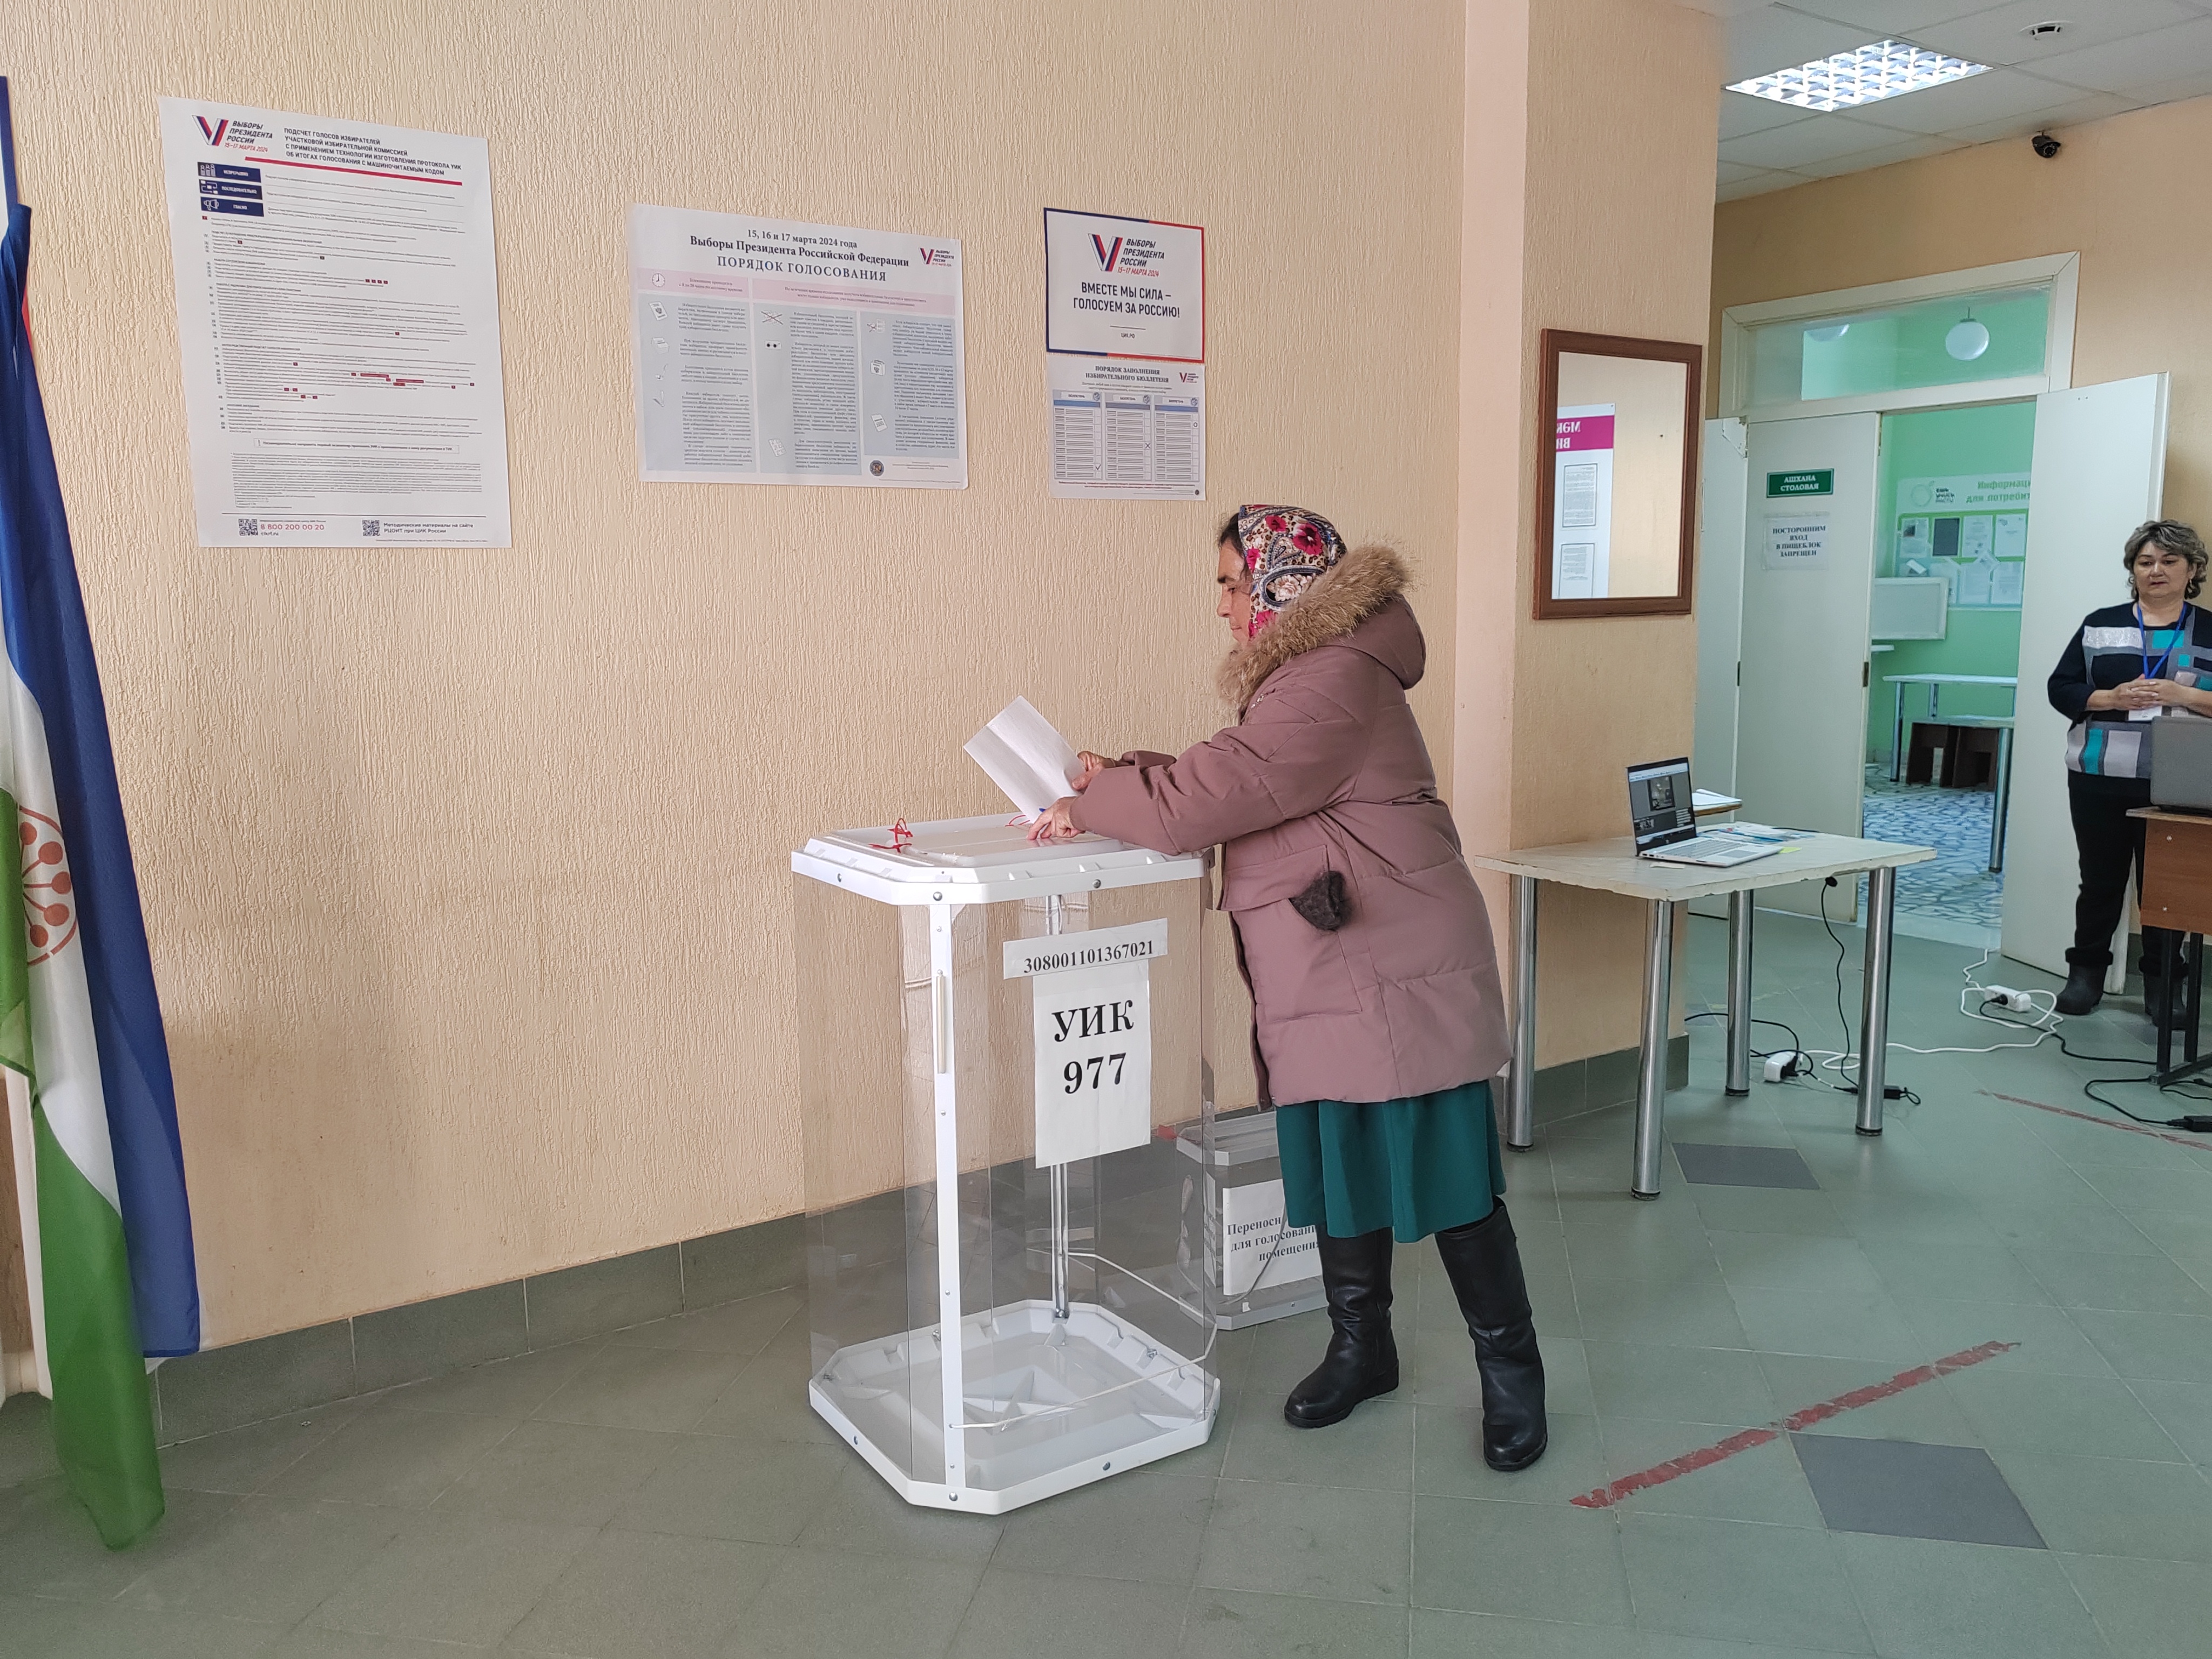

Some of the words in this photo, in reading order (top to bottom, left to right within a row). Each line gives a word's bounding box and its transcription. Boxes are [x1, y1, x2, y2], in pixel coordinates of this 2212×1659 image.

[232, 120, 264, 130] ВЫБОРЫ
[226, 136, 255, 144] РОССИИ
[229, 128, 273, 139] ПРЕЗИДЕНТА
[284, 127, 312, 137] ПОДСЧЕТ
[313, 131, 340, 140] ГОЛОСОВ
[340, 134, 380, 145] ИЗБИРАТЕЛЕЙ
[285, 136, 323, 146] УЧАСТКОВОЙ
[325, 140, 373, 152] ИЗБИРАТЕЛЬНОЙ
[374, 147, 408, 157] КОМИССИЕЙ
[291, 144, 335, 154] ПРИМЕНЕНИЕМ
[336, 149, 373, 159] ТЕХНОЛОГИИ
[373, 154, 416, 165] ИЗГОТОВЛЕНИЯ
[417, 160, 450, 170] ПРОТОКОЛА
[295, 152, 318, 160] ИТОГАХ
[319, 155, 361, 165] ГОЛОСОВАНИЯ
[367, 161, 424, 173] МАШИНОЧИТАЕМЫМ
[747, 230, 760, 239] 15,
[762, 231, 771, 239] 16
[781, 233, 791, 241] 17
[792, 235, 817, 245] марта
[819, 237, 838, 246] 2024
[840, 240, 858, 249] года
[1126, 238, 1156, 248] ВЫБОРЫ
[690, 235, 733, 251] Выборы
[736, 240, 797, 255] Президента
[799, 247, 855, 261] Российской
[858, 253, 909, 267] Федерации
[1123, 248, 1165, 259] ПРЕЗИДЕНТА
[717, 255, 784, 273] ПОРЯДОК
[788, 262, 887, 282] ГОЛОСОВАНИЯ
[1120, 257, 1147, 267] РОССИИ
[1131, 268, 1147, 276] МАРТА
[1081, 281, 1118, 296] ВМЕСТЕ
[1121, 286, 1137, 298] МЫ
[1139, 287, 1163, 301] СИЛА
[1074, 298, 1122, 313] ГОЛОСУЕМ
[1125, 302, 1136, 314] ЗА
[1139, 304, 1180, 318] РОССИЮ!
[1085, 372, 1135, 381] ИЗБИРАТЕЛЬНОГО
[1095, 365, 1122, 373] ПОРЯДОК
[1123, 367, 1160, 375] ЗАПОЛНЕНИЯ
[1784, 475, 1816, 483] АШХАНА
[1780, 483, 1819, 491] СТОЛОВАЯ
[1772, 525, 1826, 534] ПОСТОРОННИМ
[1023, 940, 1154, 973] 308001101367021
[1051, 1000, 1134, 1042] УИК
[1063, 1052, 1127, 1095] 977
[1230, 1239, 1251, 1253] для
